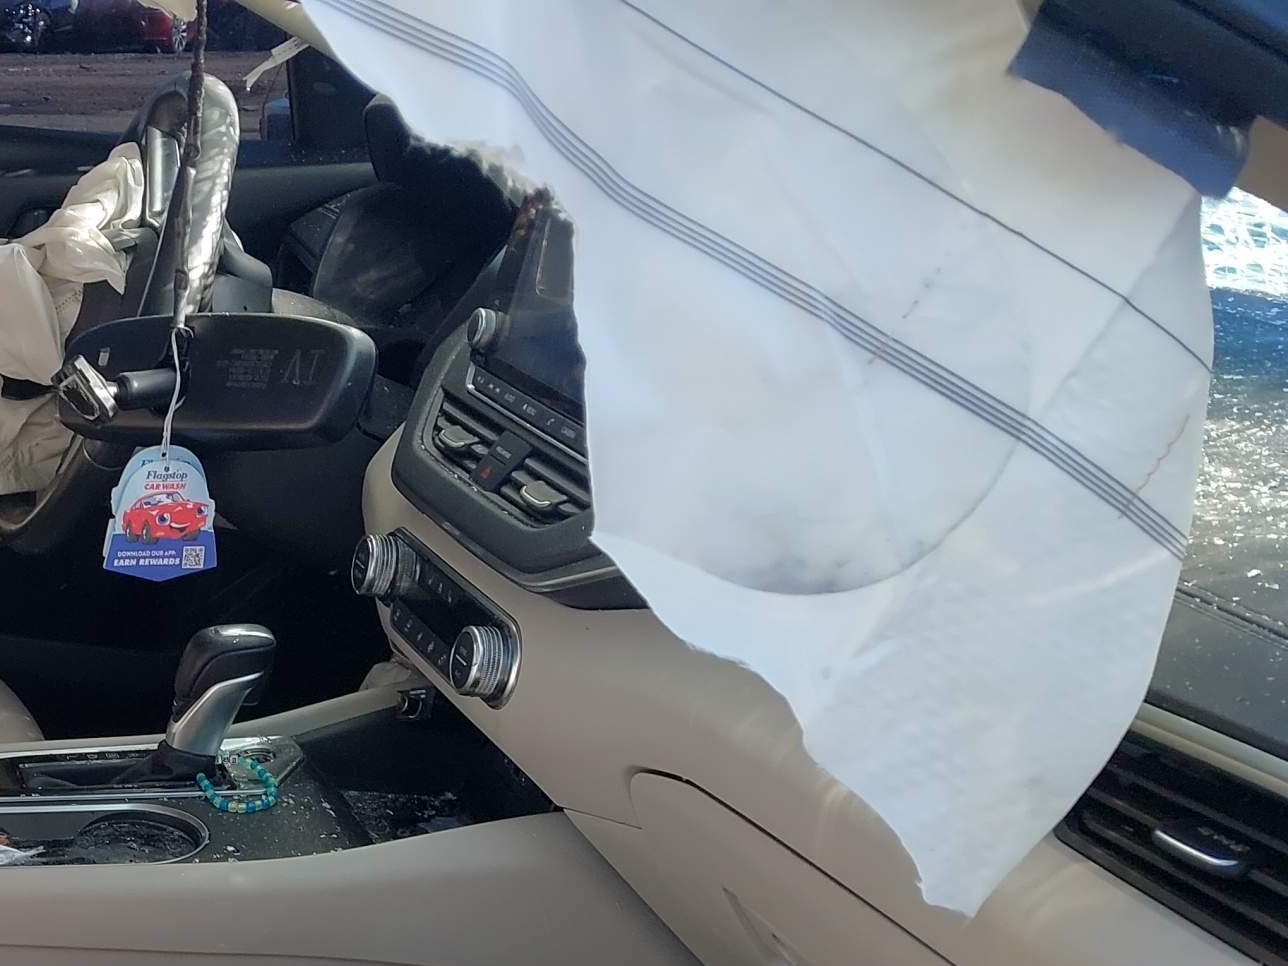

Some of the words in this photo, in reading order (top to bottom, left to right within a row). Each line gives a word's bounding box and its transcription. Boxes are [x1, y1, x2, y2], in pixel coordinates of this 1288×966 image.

[146, 470, 188, 481] Flagstop
[113, 559, 137, 567] EARN
[139, 558, 180, 566] REWARDS
